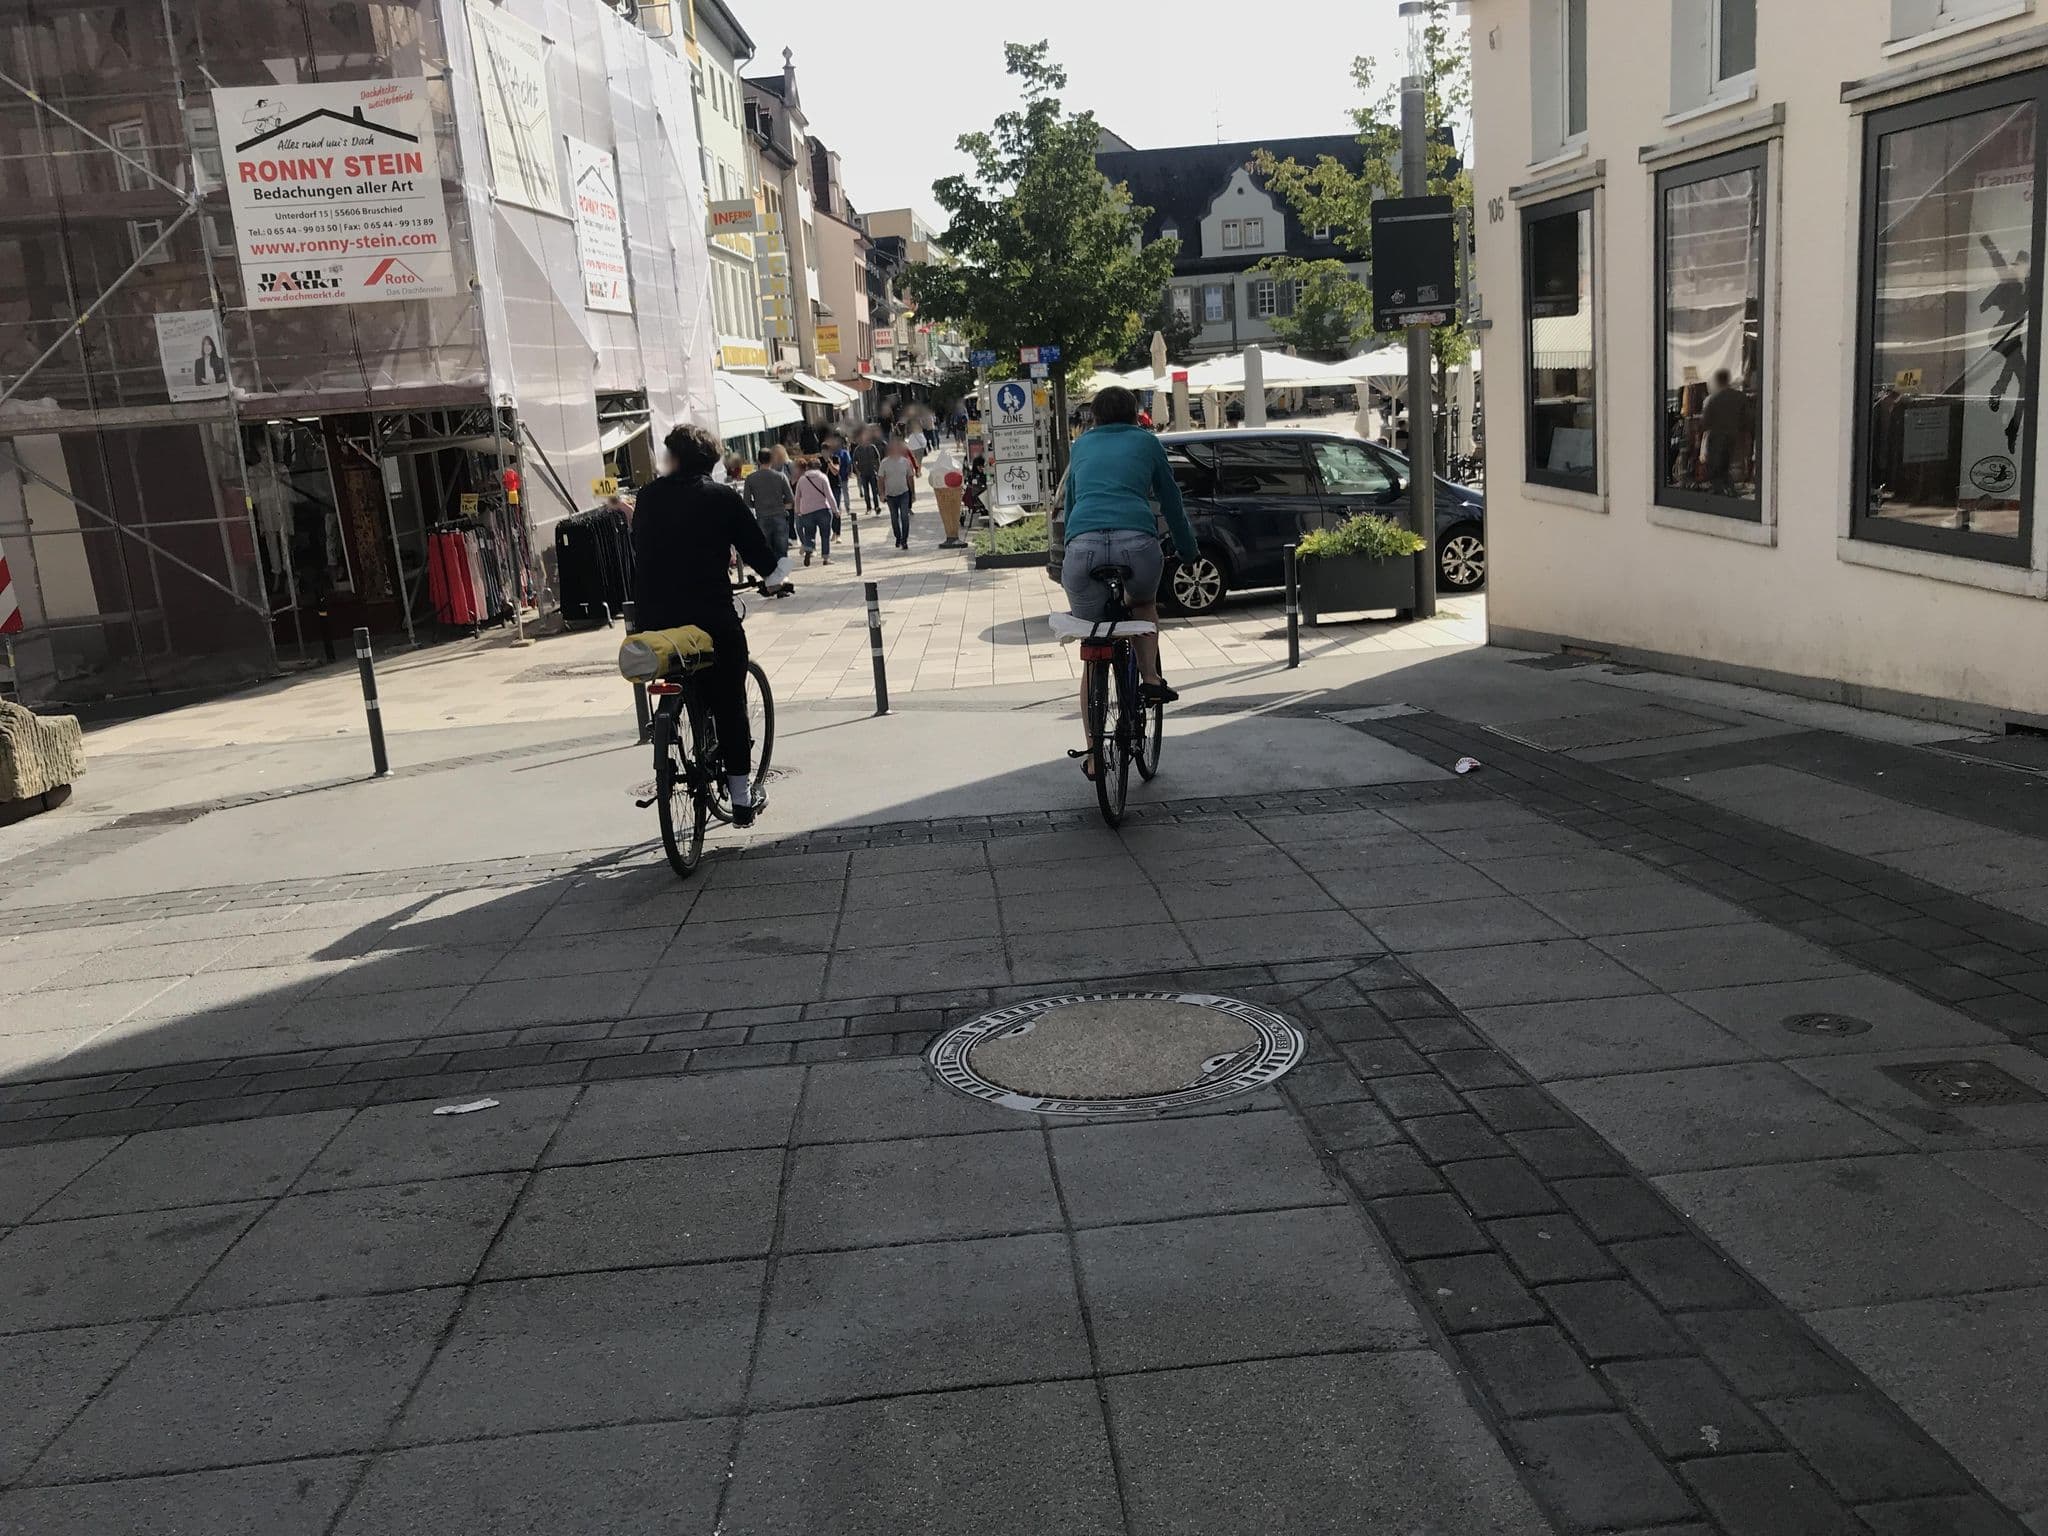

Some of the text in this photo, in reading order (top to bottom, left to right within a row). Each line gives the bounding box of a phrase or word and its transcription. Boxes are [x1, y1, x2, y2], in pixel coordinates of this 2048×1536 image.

[277, 139, 299, 151] Alles
[302, 137, 325, 149] rund
[351, 134, 375, 147] Dach
[238, 152, 423, 183] RONNY STEIN
[253, 179, 414, 201] Bedachungen aller Art
[275, 210, 317, 220] Unterdorf
[319, 210, 329, 218] 15
[362, 205, 403, 215] Bruschied
[713, 210, 753, 226] INFERNO
[1488, 196, 1504, 224] 106
[343, 222, 360, 231] Fax:
[250, 232, 438, 255] www.ronny-stein.com
[385, 273, 415, 285] Roto
[1002, 413, 1024, 424] ZONE
[1011, 482, 1025, 490] frei
